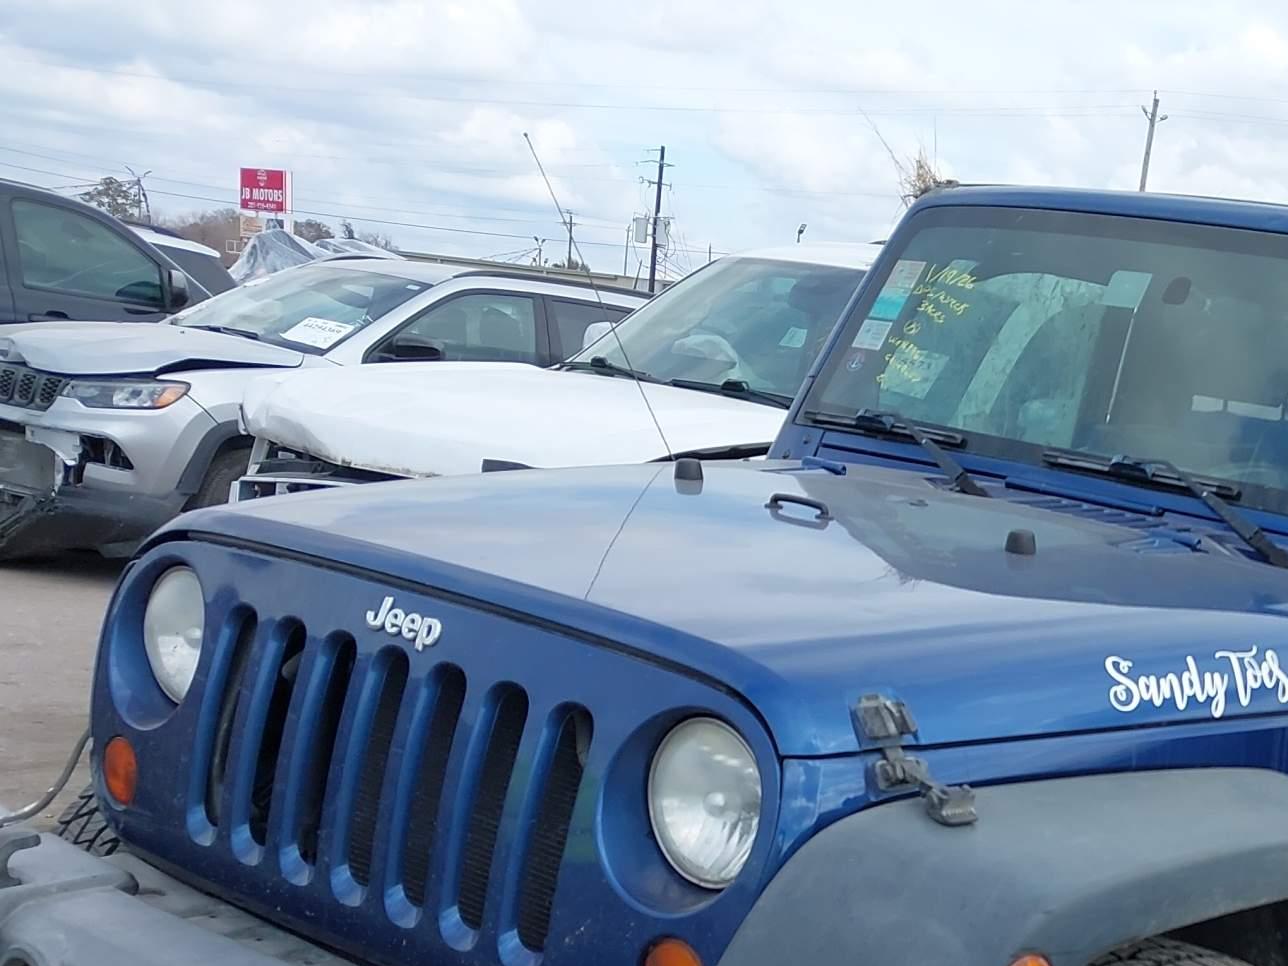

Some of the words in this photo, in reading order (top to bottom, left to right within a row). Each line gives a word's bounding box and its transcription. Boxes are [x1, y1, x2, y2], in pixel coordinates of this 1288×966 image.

[242, 187, 251, 200] JB
[252, 188, 283, 202] MOTORS
[366, 596, 442, 652] Jeep
[1104, 655, 1229, 719] Sandy
